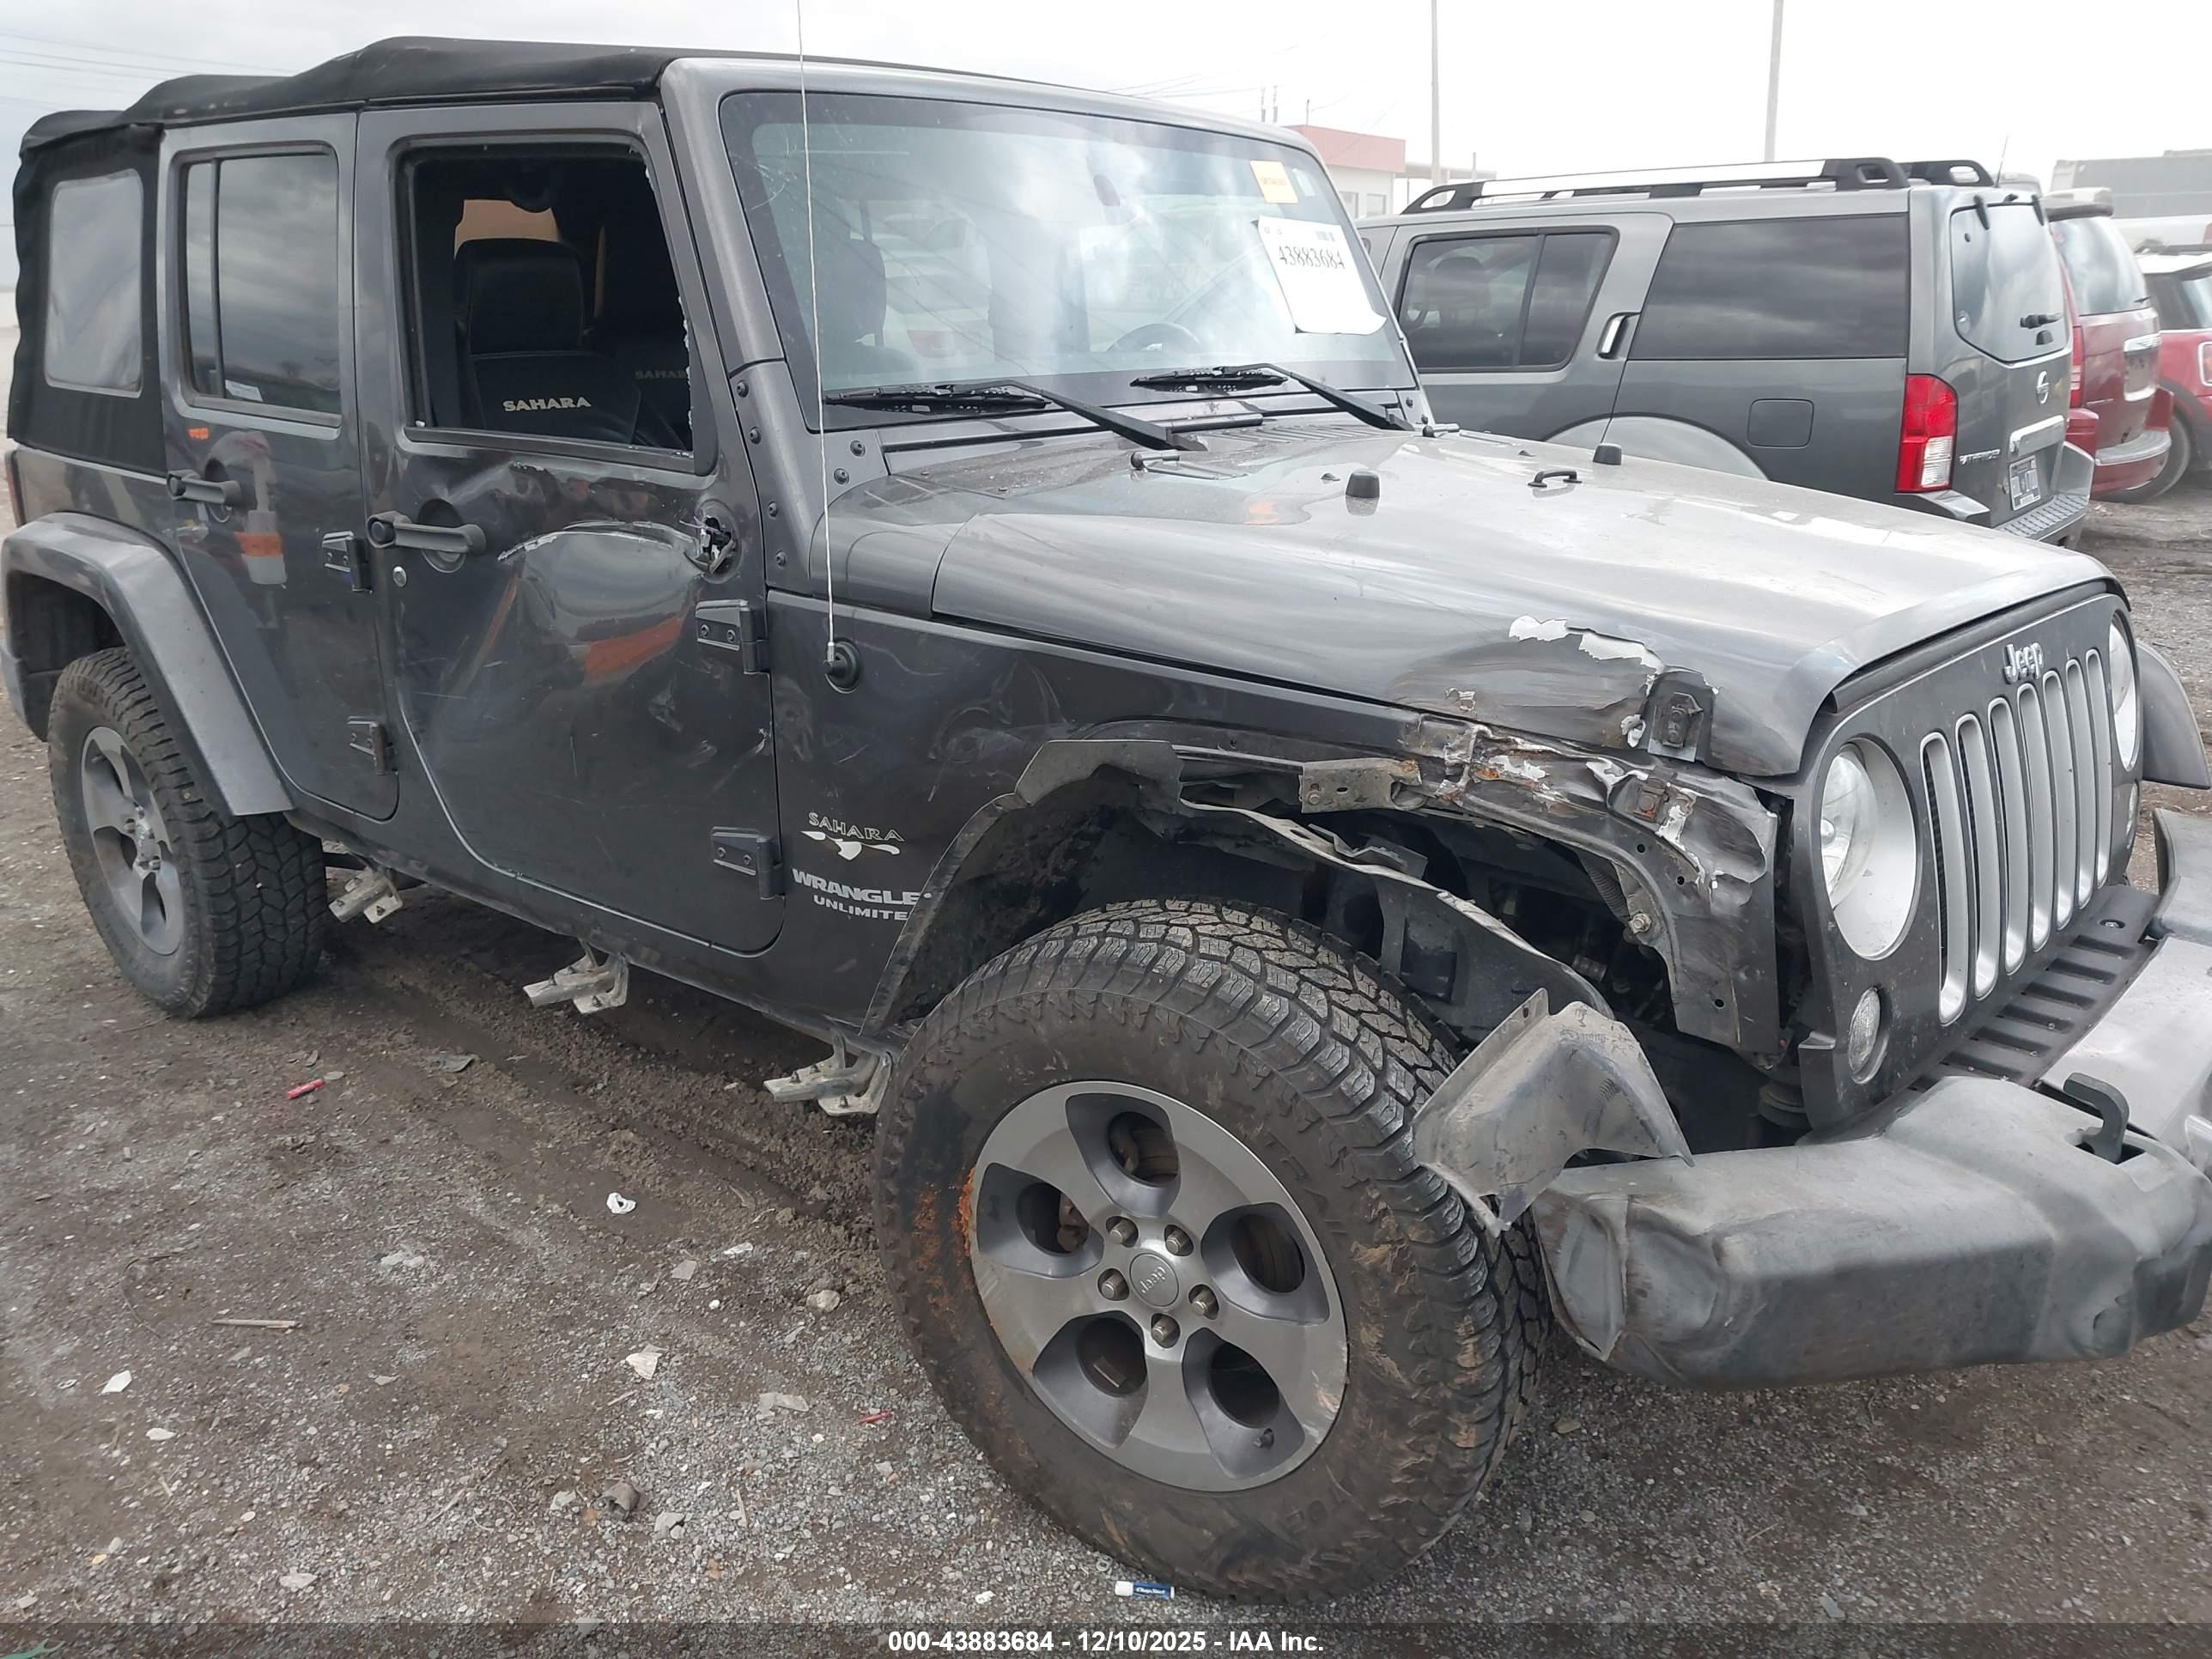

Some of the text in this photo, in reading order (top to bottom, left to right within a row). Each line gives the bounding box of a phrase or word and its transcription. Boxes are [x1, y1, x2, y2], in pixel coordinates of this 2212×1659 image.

[1279, 246, 1346, 270] 43883684
[635, 370, 688, 380] SAHAR
[502, 397, 592, 412] SAHARA
[2003, 642, 2043, 683] Jeep
[808, 811, 905, 842] SAHARA
[792, 868, 922, 906] WRANGLE
[813, 895, 909, 921] UNLIMITE
[1139, 1266, 1166, 1293] Jeep
